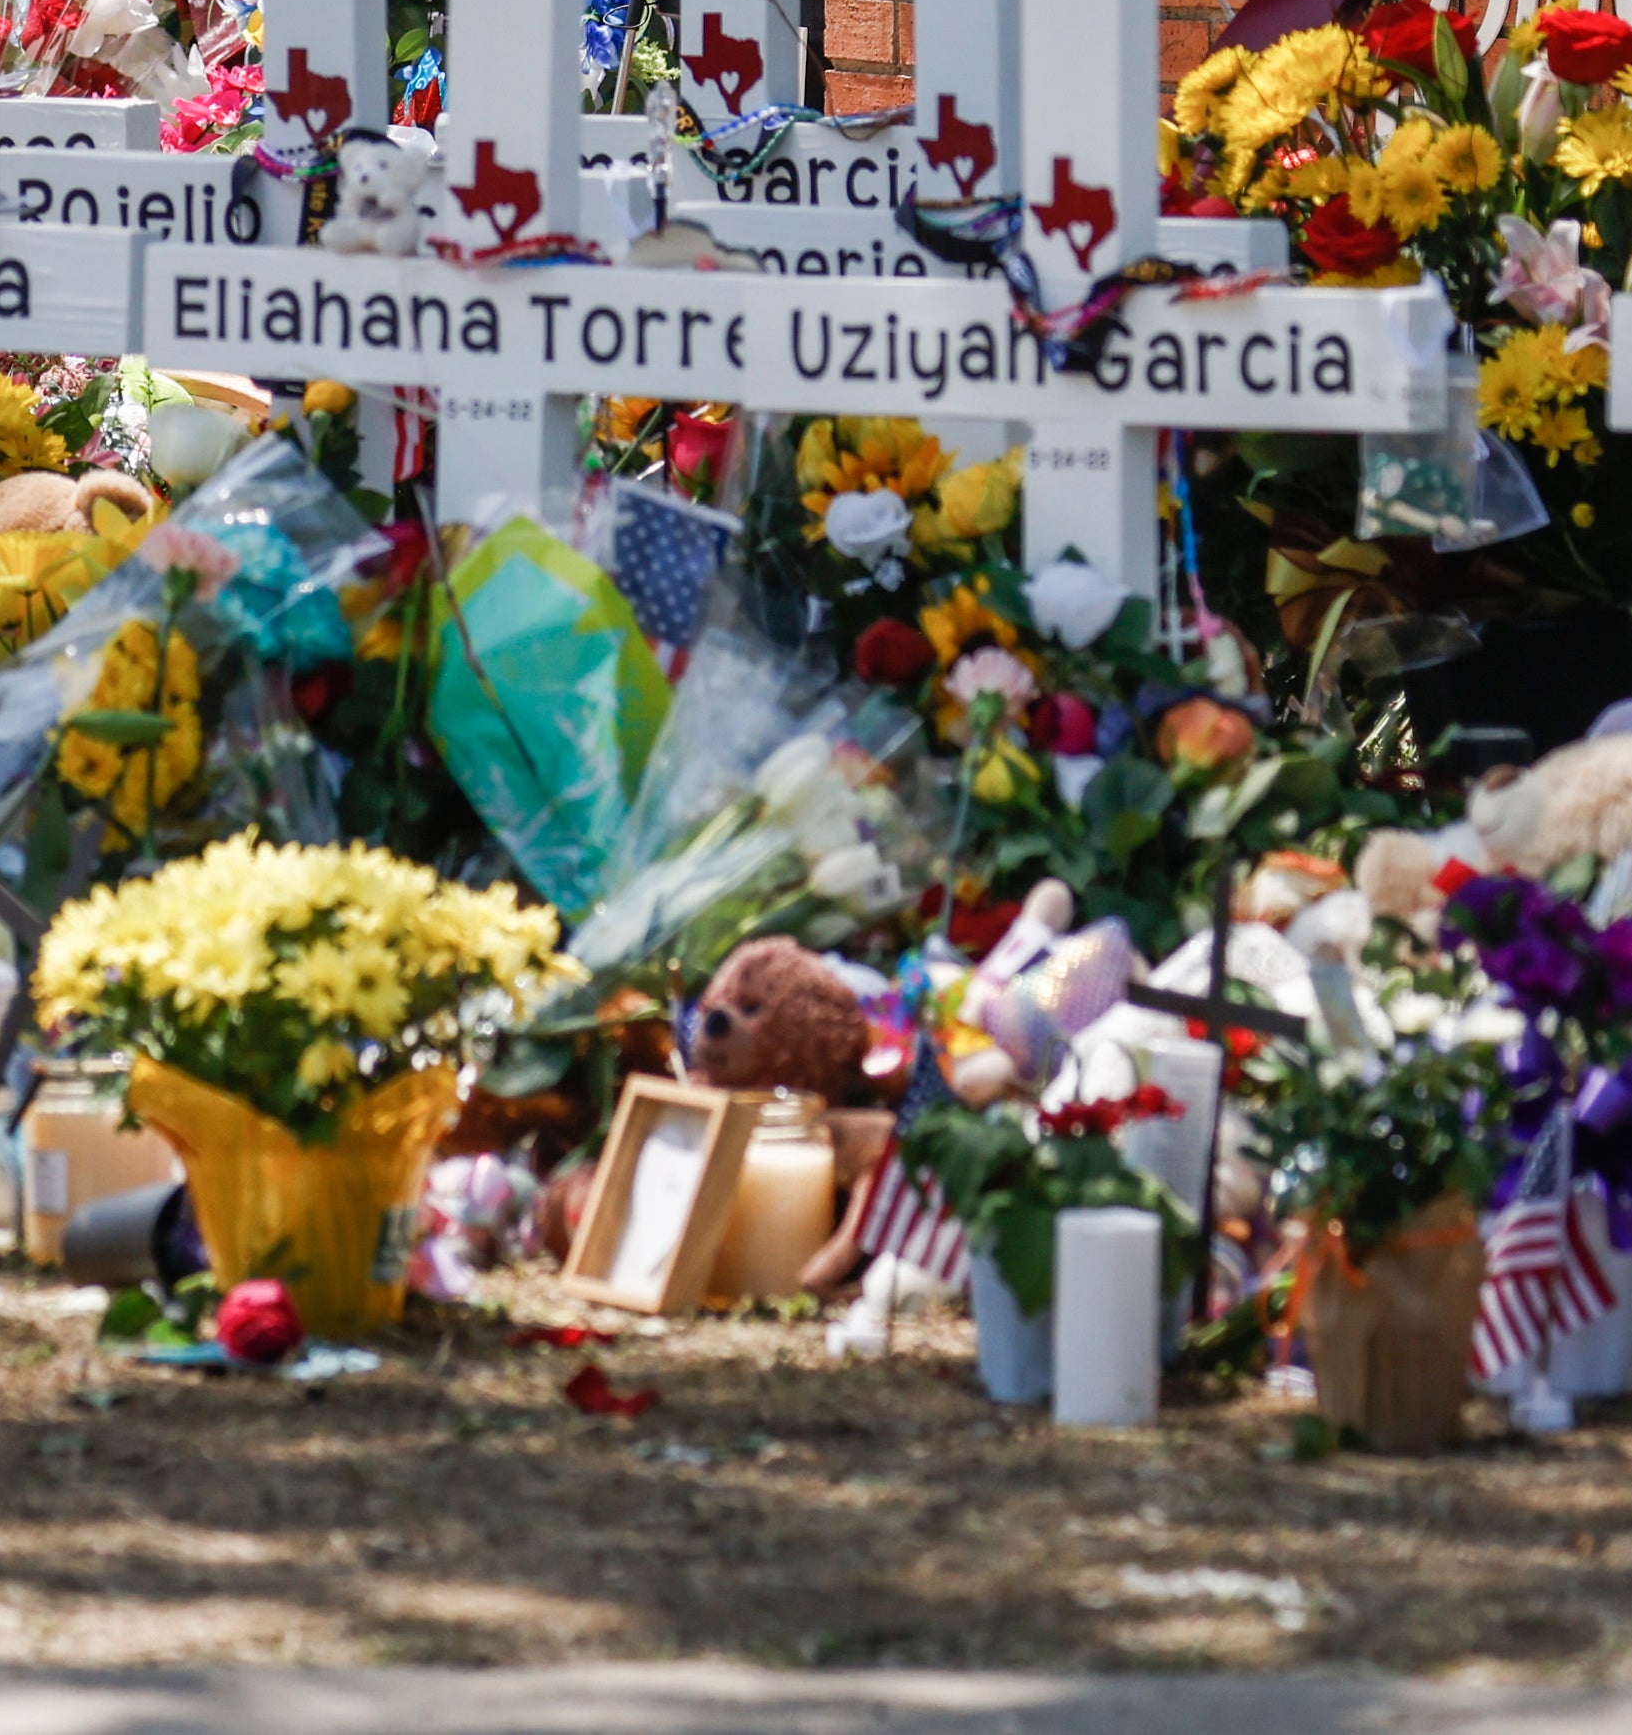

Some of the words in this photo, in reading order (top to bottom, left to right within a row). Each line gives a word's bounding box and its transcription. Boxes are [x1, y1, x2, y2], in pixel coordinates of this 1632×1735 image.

[717, 147, 918, 209] Garci
[173, 275, 500, 355] Eliahana
[530, 295, 744, 367] Torre
[791, 308, 1047, 398] Uziyah
[1094, 321, 1355, 395] Garcia
